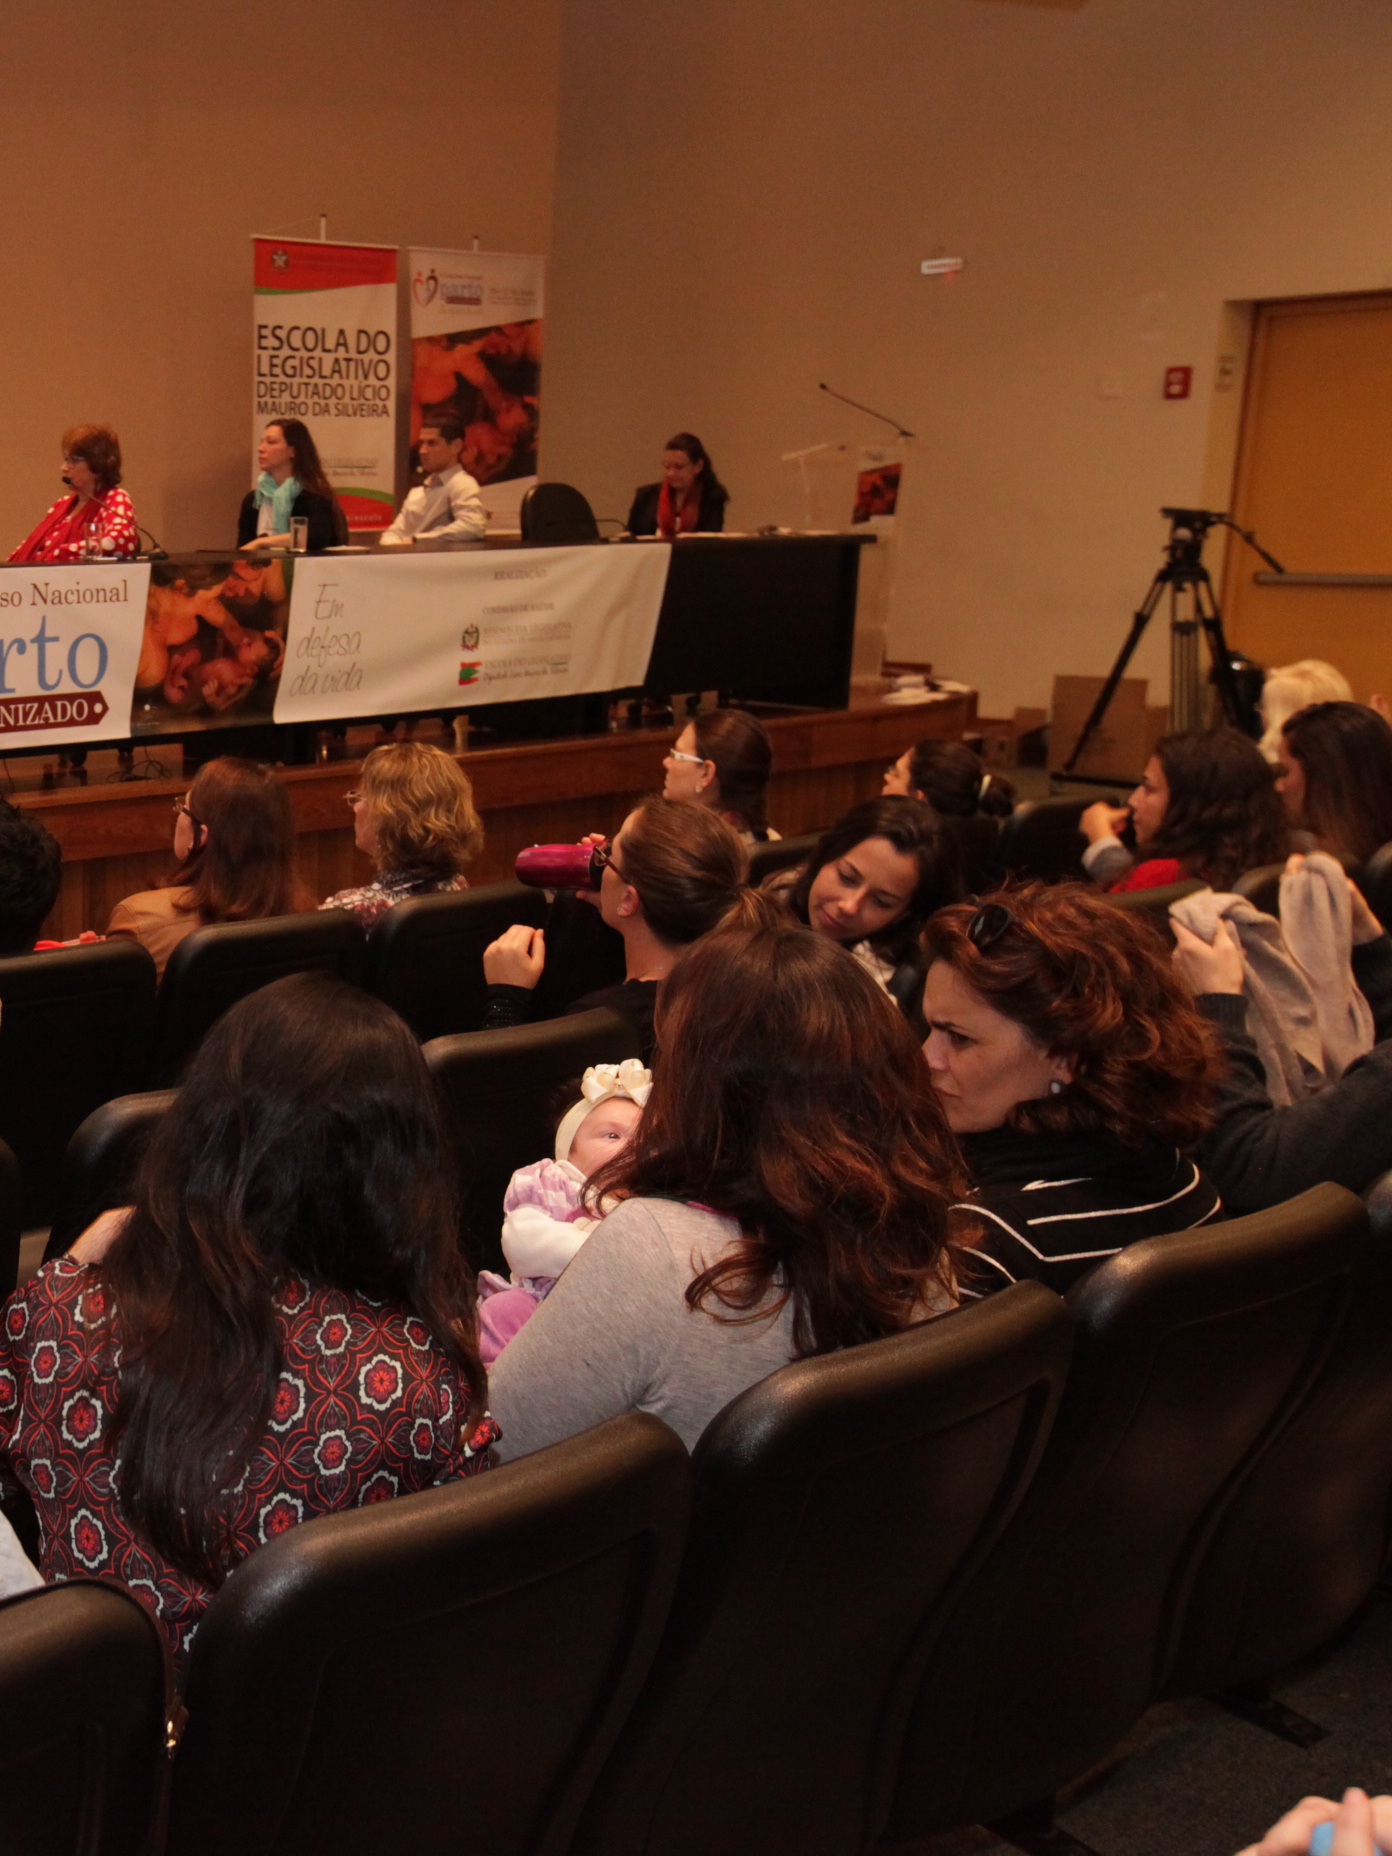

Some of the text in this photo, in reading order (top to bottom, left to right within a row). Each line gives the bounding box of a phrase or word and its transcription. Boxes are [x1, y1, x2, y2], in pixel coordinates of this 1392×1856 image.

[257, 324, 391, 355] ESCOLA DO
[257, 354, 391, 382] LEGISLATIVO
[257, 380, 346, 401] DEPUTADO
[257, 401, 390, 418] MAURO DA SILVEIRA
[30, 580, 128, 607] Nacional
[315, 583, 344, 620] Em
[296, 626, 361, 668] defesa
[289, 661, 363, 697] da vida
